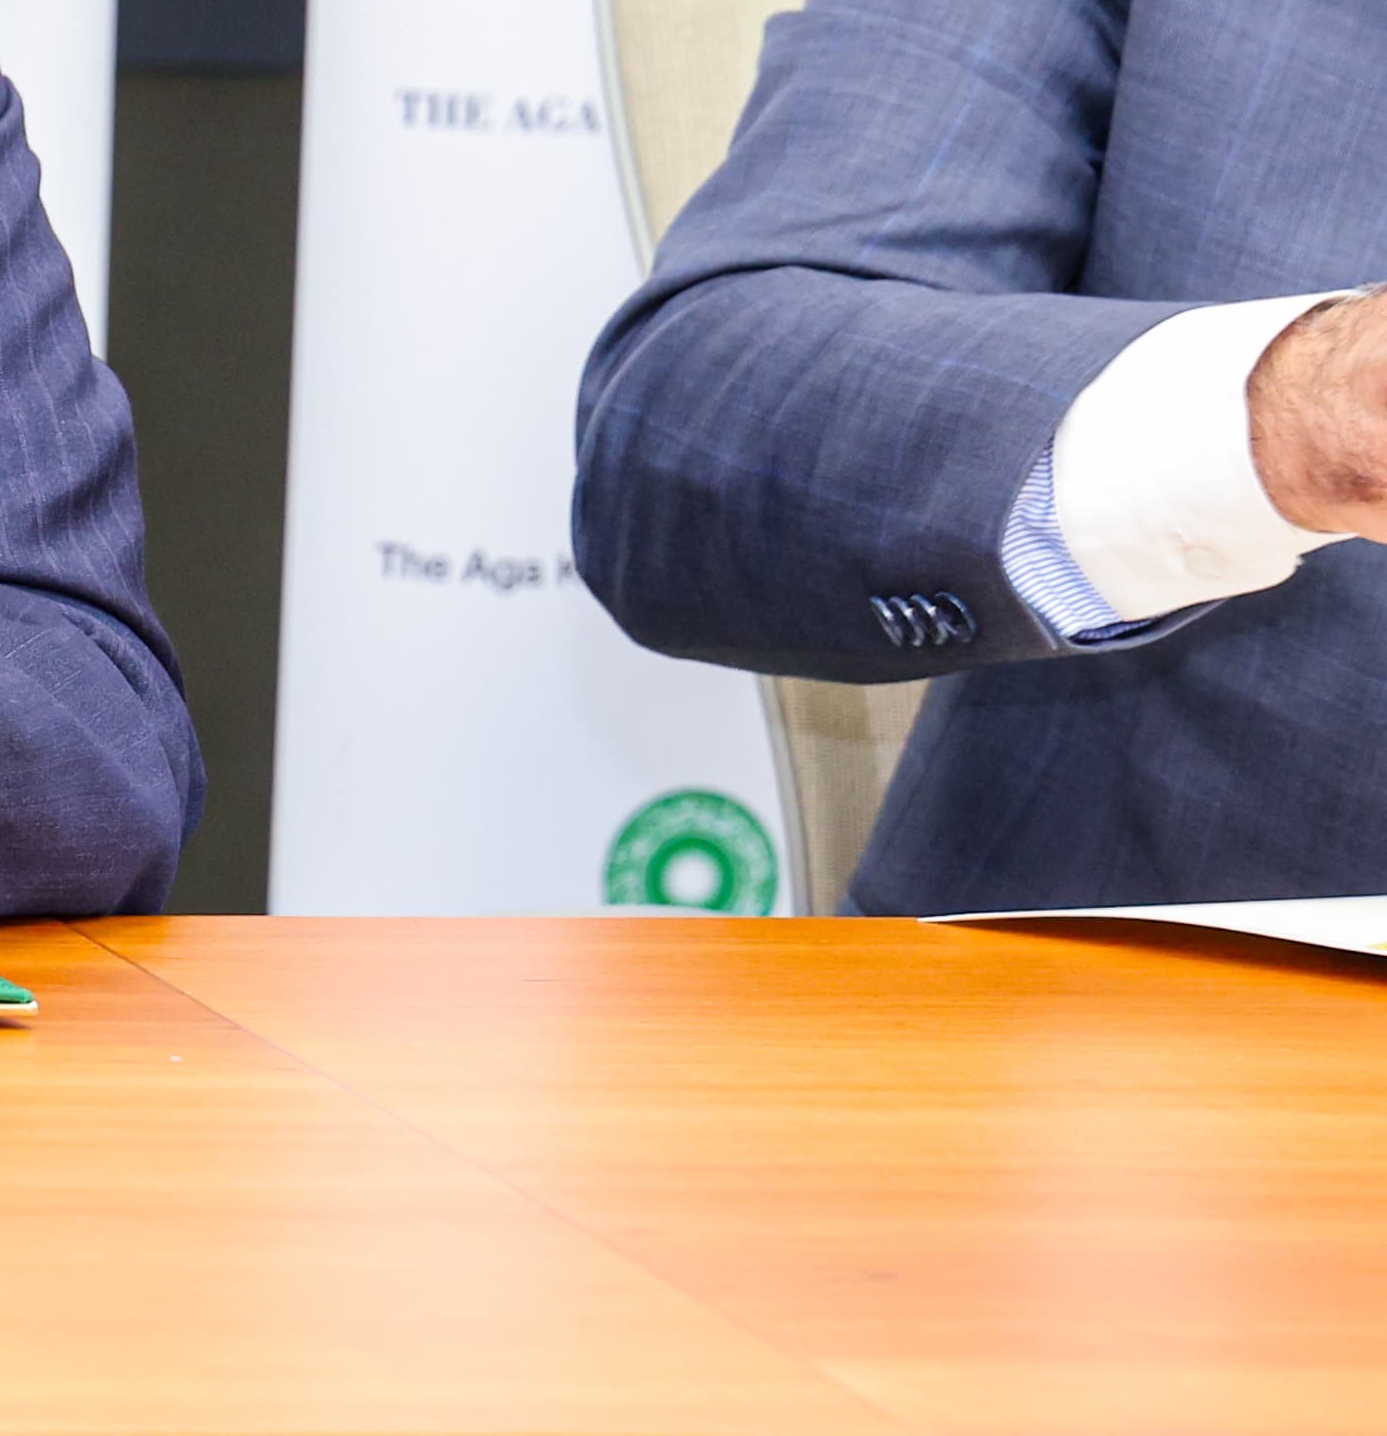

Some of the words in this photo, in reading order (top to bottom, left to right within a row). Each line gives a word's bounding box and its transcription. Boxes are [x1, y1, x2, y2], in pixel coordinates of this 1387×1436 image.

[395, 87, 494, 131] THE
[506, 96, 603, 137] AGA
[376, 540, 450, 583] The
[461, 548, 546, 596] Aga
